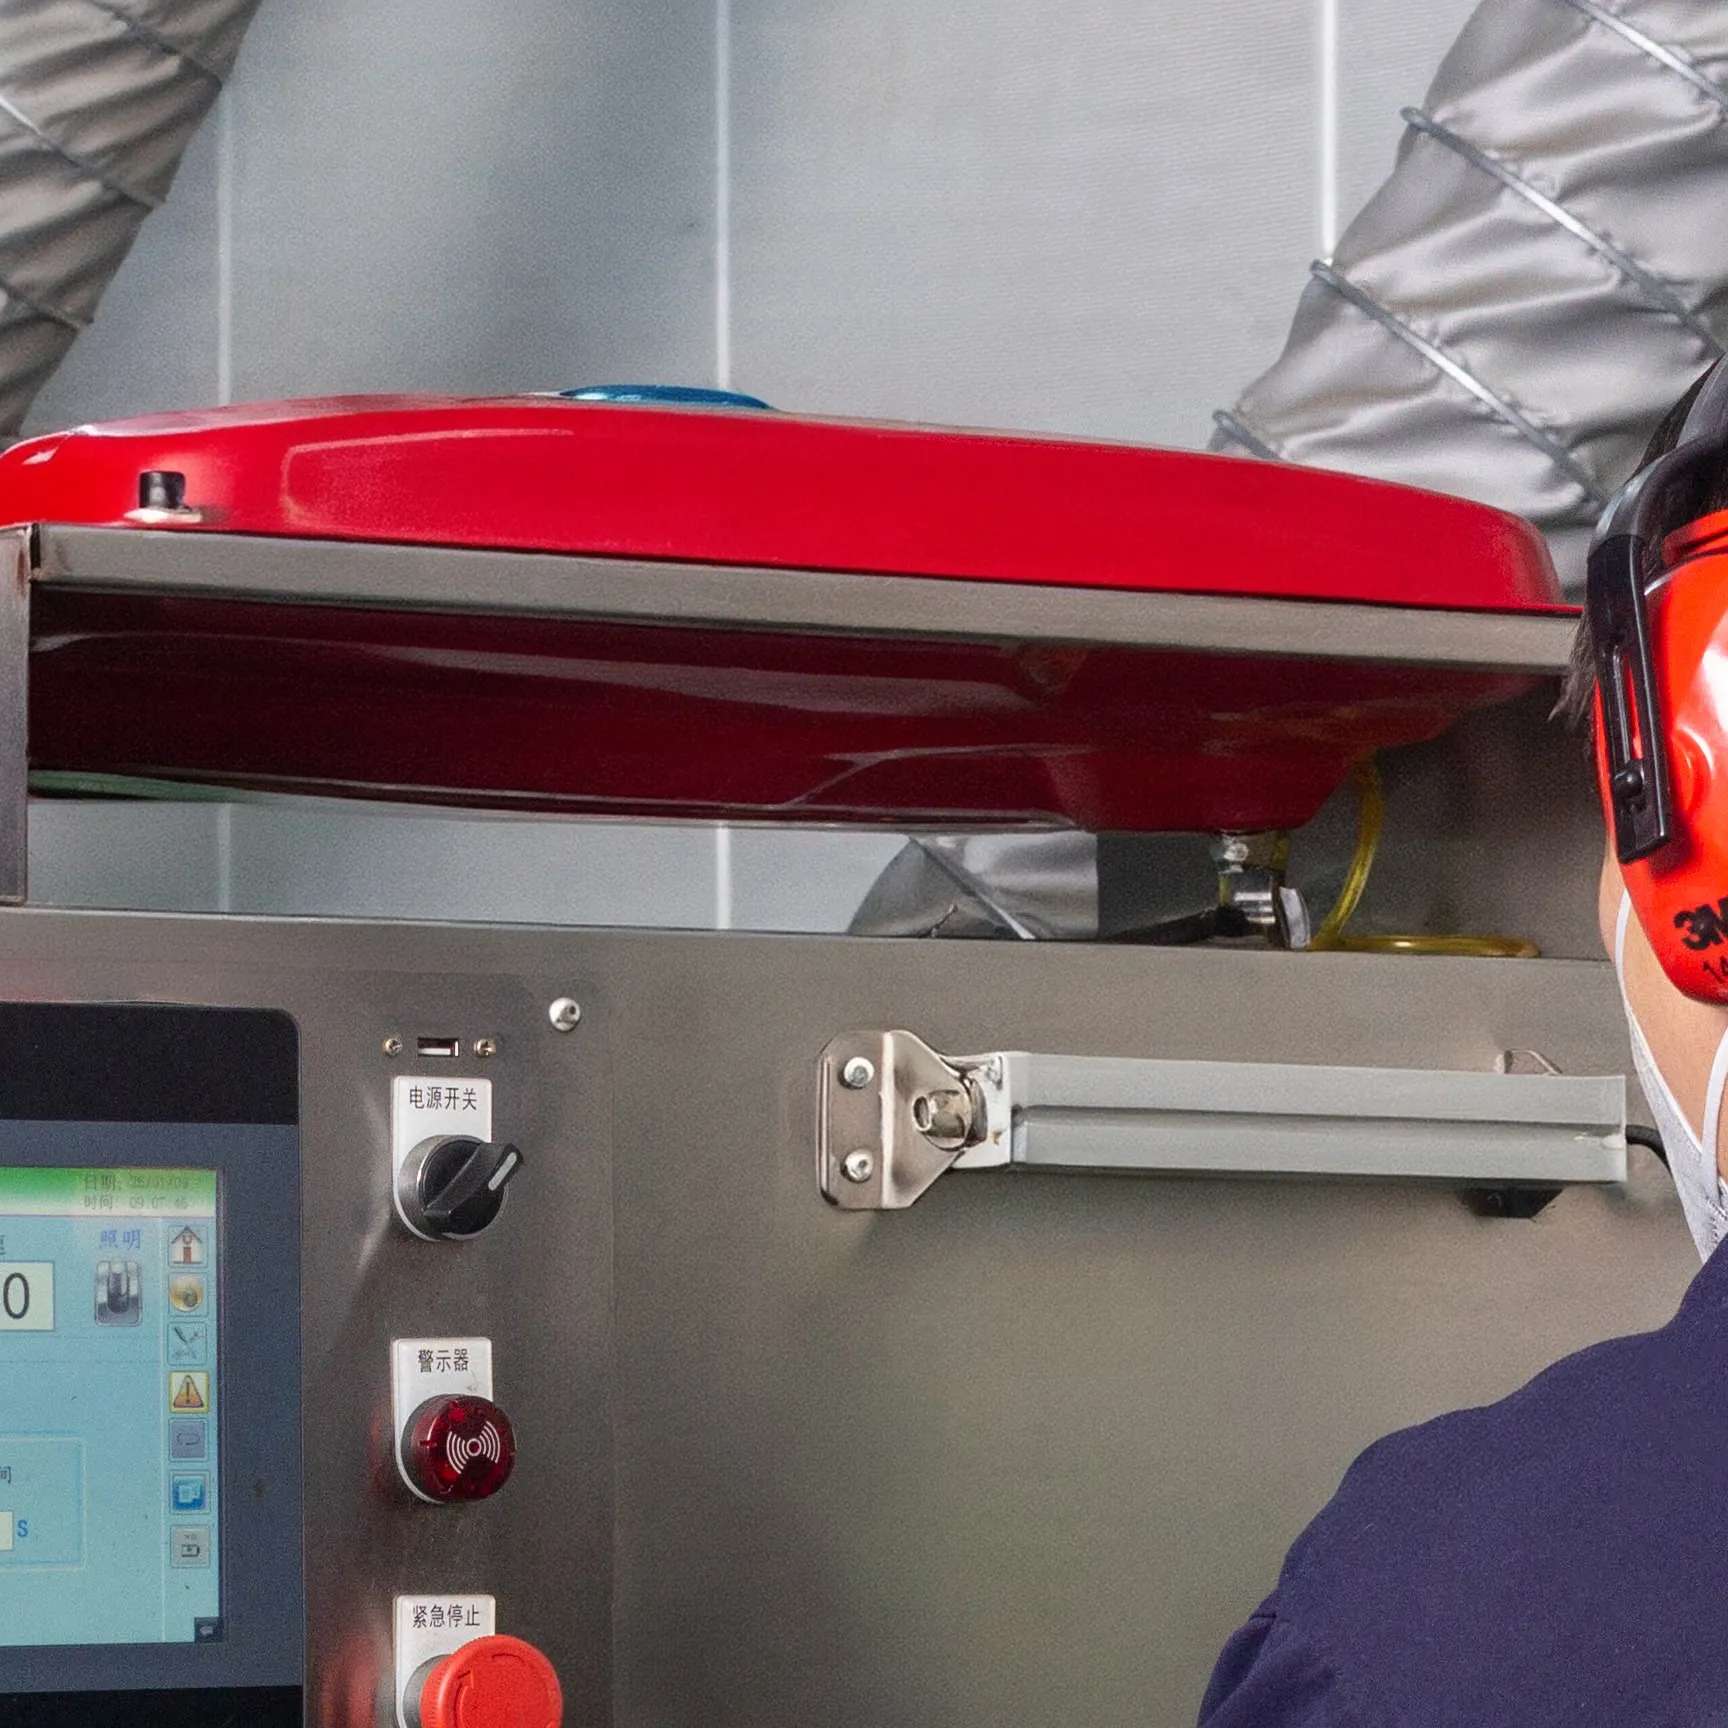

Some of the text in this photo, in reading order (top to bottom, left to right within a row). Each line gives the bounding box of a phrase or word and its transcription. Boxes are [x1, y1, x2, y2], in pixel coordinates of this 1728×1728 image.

[409, 1085, 477, 1111] 电源开关
[99, 1229, 142, 1249] 照明
[417, 1348, 470, 1374] 警示器
[412, 1603, 480, 1628] 紧急停止
